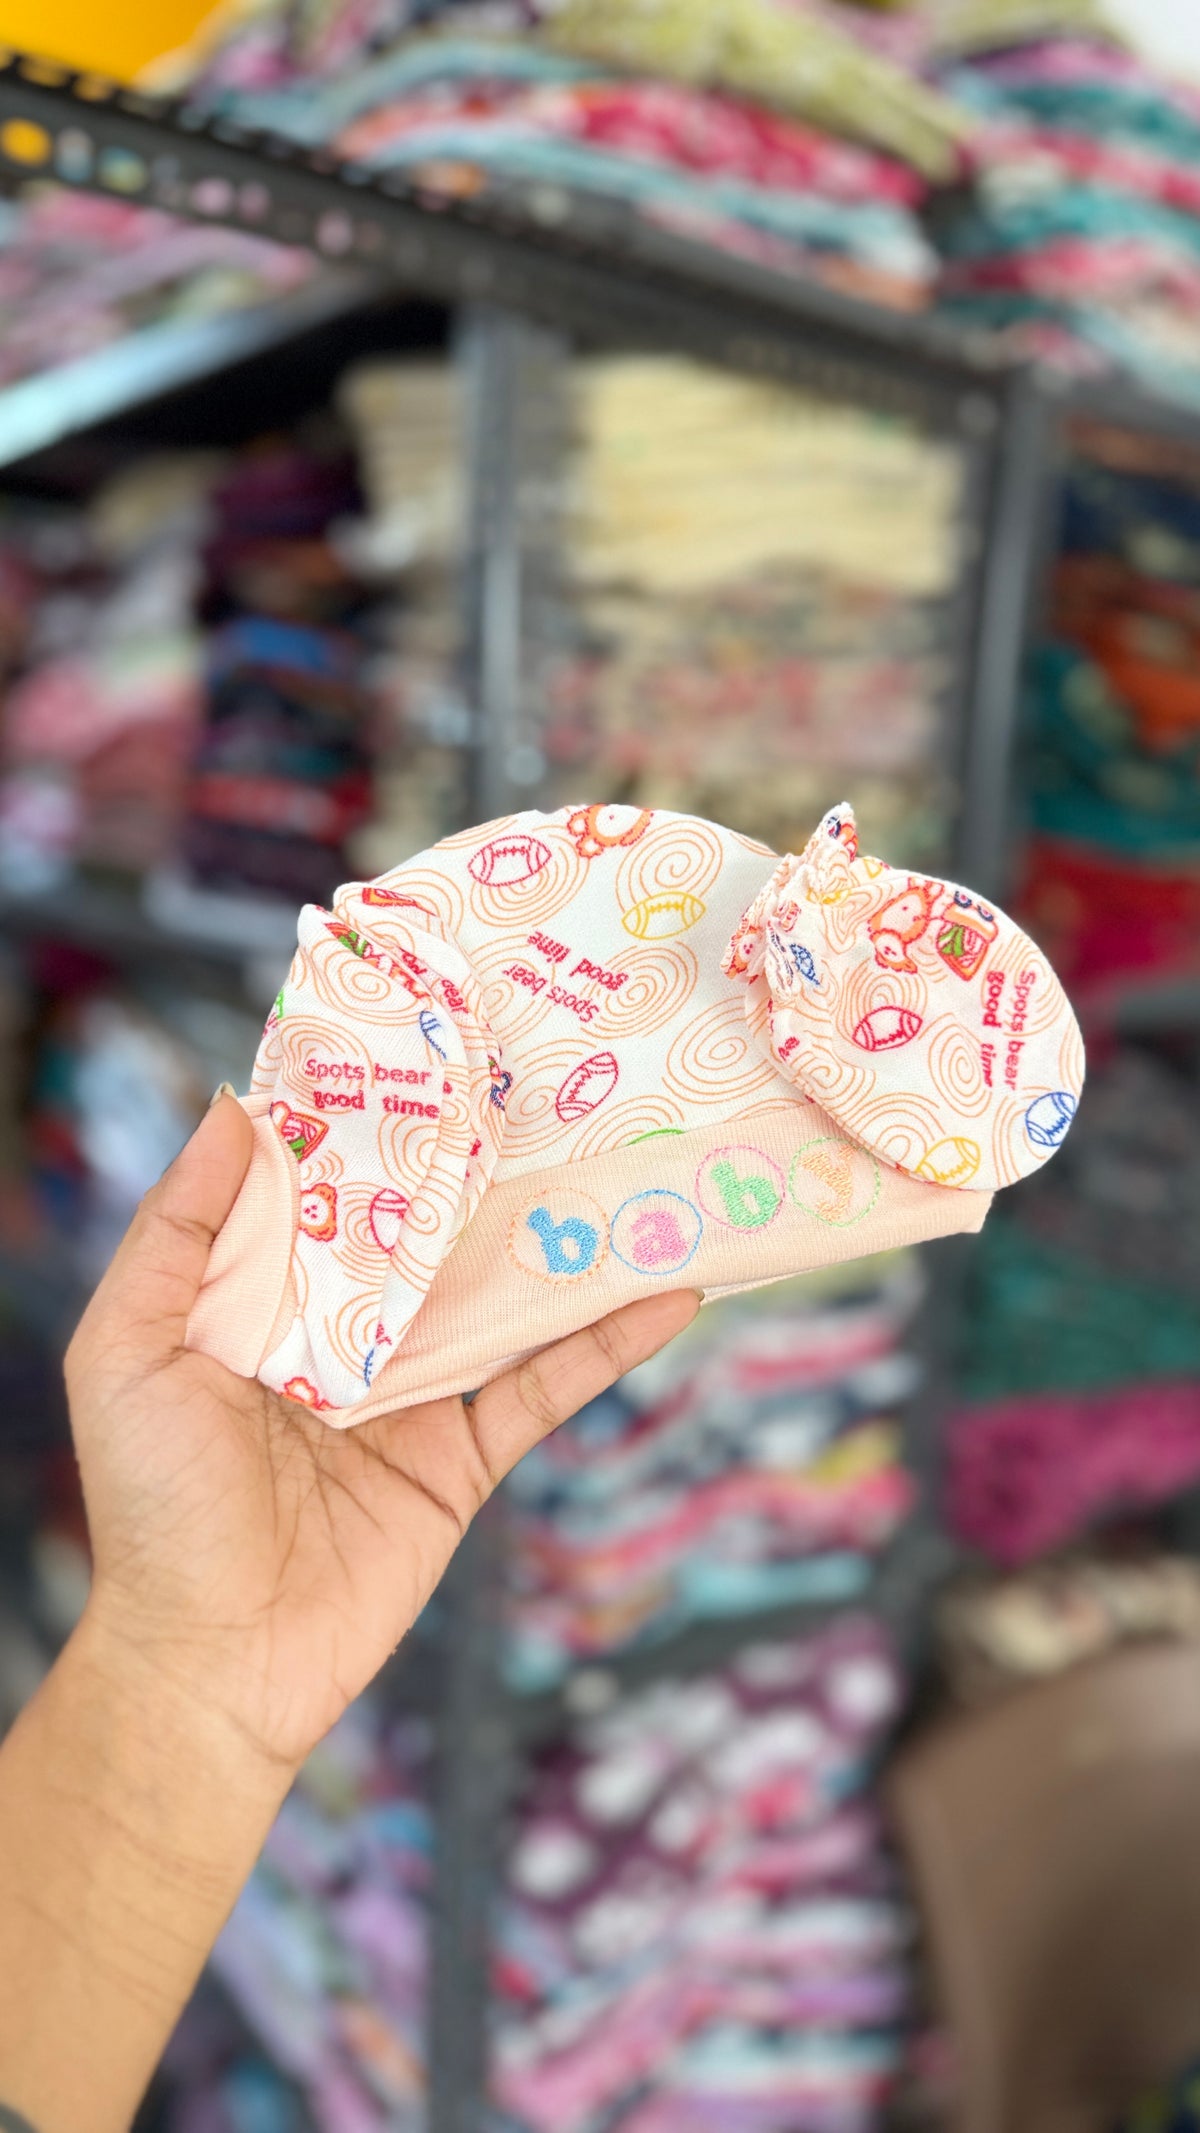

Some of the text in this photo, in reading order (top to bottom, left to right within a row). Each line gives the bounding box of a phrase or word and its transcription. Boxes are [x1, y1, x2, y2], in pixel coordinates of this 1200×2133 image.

[527, 931, 629, 991] good time
[502, 964, 599, 1023] Spots bear
[983, 970, 1005, 1028] good
[1004, 971, 1036, 1091] Spots bear
[304, 1059, 432, 1085] Spots bear
[313, 1089, 440, 1119] good time
